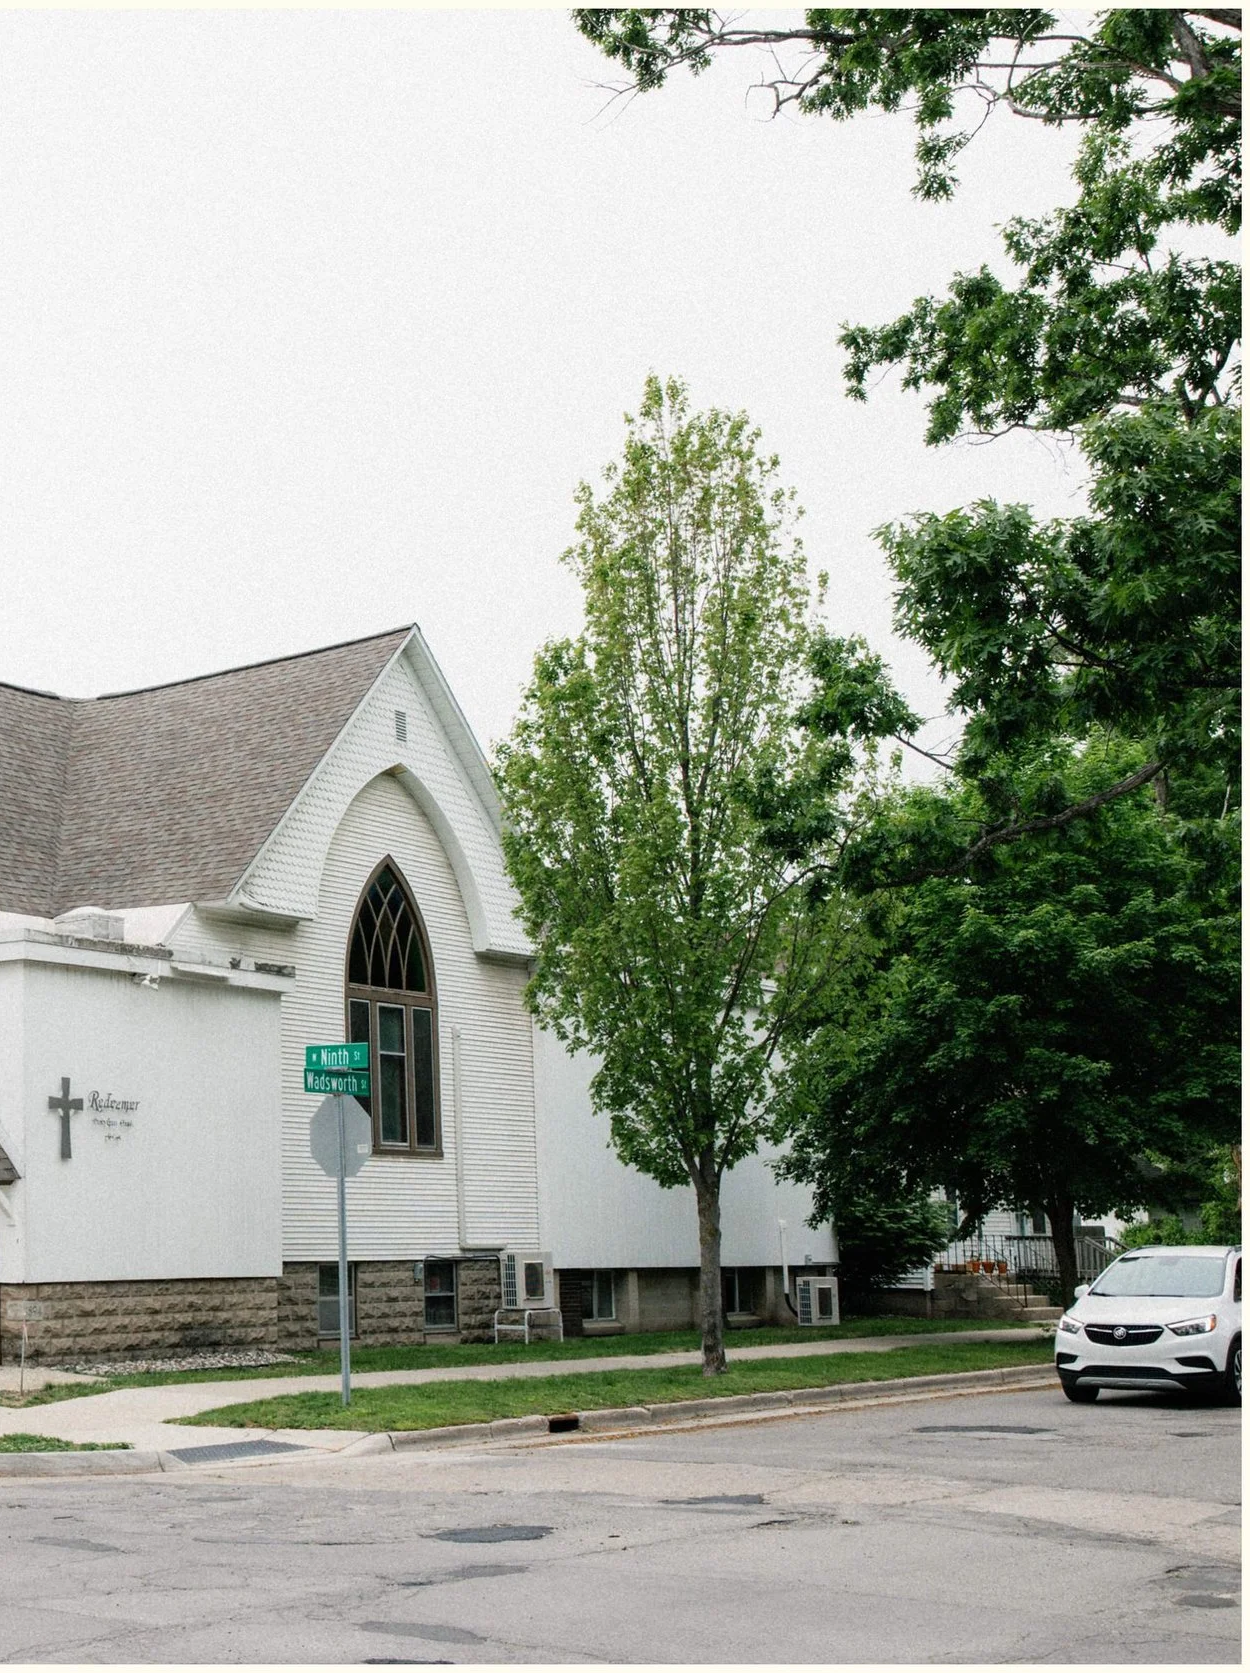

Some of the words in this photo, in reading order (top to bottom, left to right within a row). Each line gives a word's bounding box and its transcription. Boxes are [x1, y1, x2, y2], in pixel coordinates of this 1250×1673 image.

[320, 1048, 349, 1066] Ninth
[353, 1051, 361, 1061] St
[306, 1071, 358, 1092] Wadsworth
[361, 1080, 367, 1089] St
[88, 1090, 141, 1113] Redeemer
